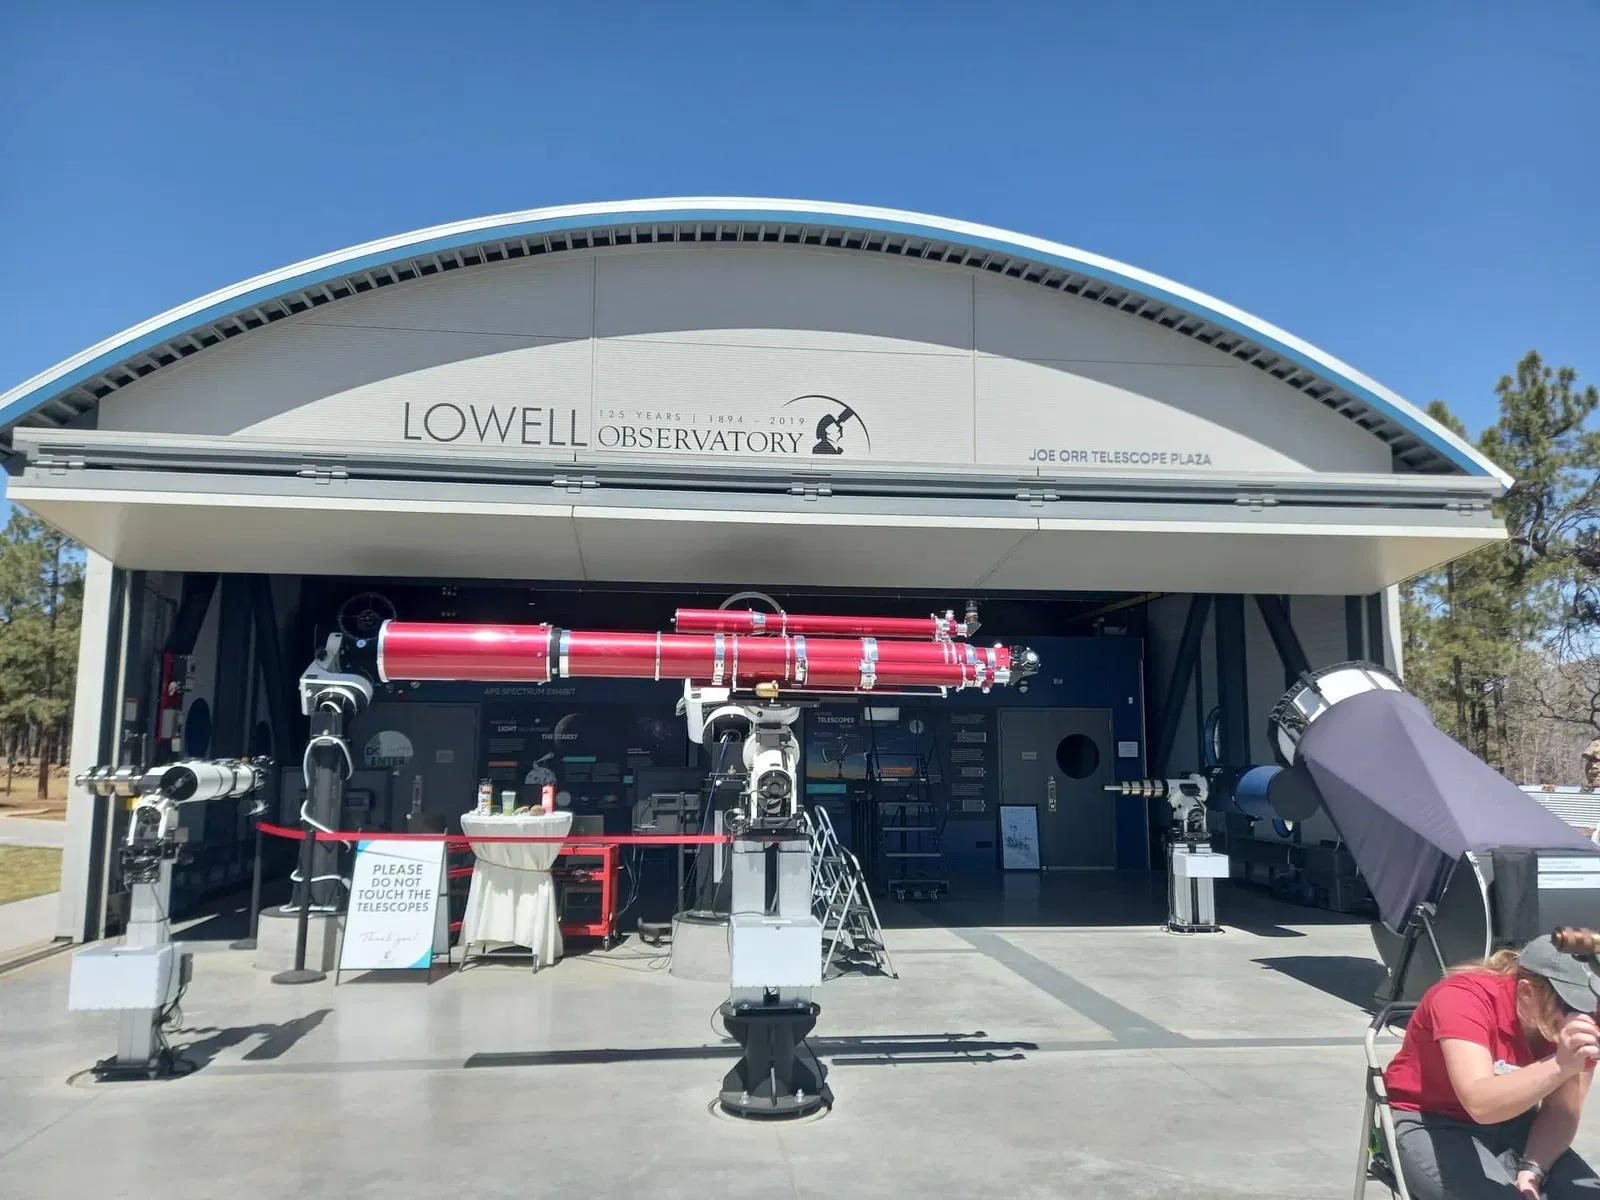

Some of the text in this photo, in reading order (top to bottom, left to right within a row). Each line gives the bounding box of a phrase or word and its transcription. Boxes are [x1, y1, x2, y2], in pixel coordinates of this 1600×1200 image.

[599, 409, 625, 418] 125
[636, 411, 681, 421] YEARS
[709, 415, 743, 424] 1894
[769, 416, 805, 425] 2019
[404, 401, 804, 454] LOWELL OBSERVATORY
[1028, 448, 1212, 466] JOE ORR TELESCOPE PLAZA
[484, 687, 576, 696] APS SPECTRUM EXHIBIT
[817, 716, 855, 724] TELESCOPES
[366, 746, 383, 756] DO
[371, 756, 405, 765] ENTER
[372, 864, 423, 876] PLEASE
[371, 877, 422, 888] DO NOT
[358, 889, 432, 900] TOUCH THE
[356, 902, 429, 913] TELESCOPES
